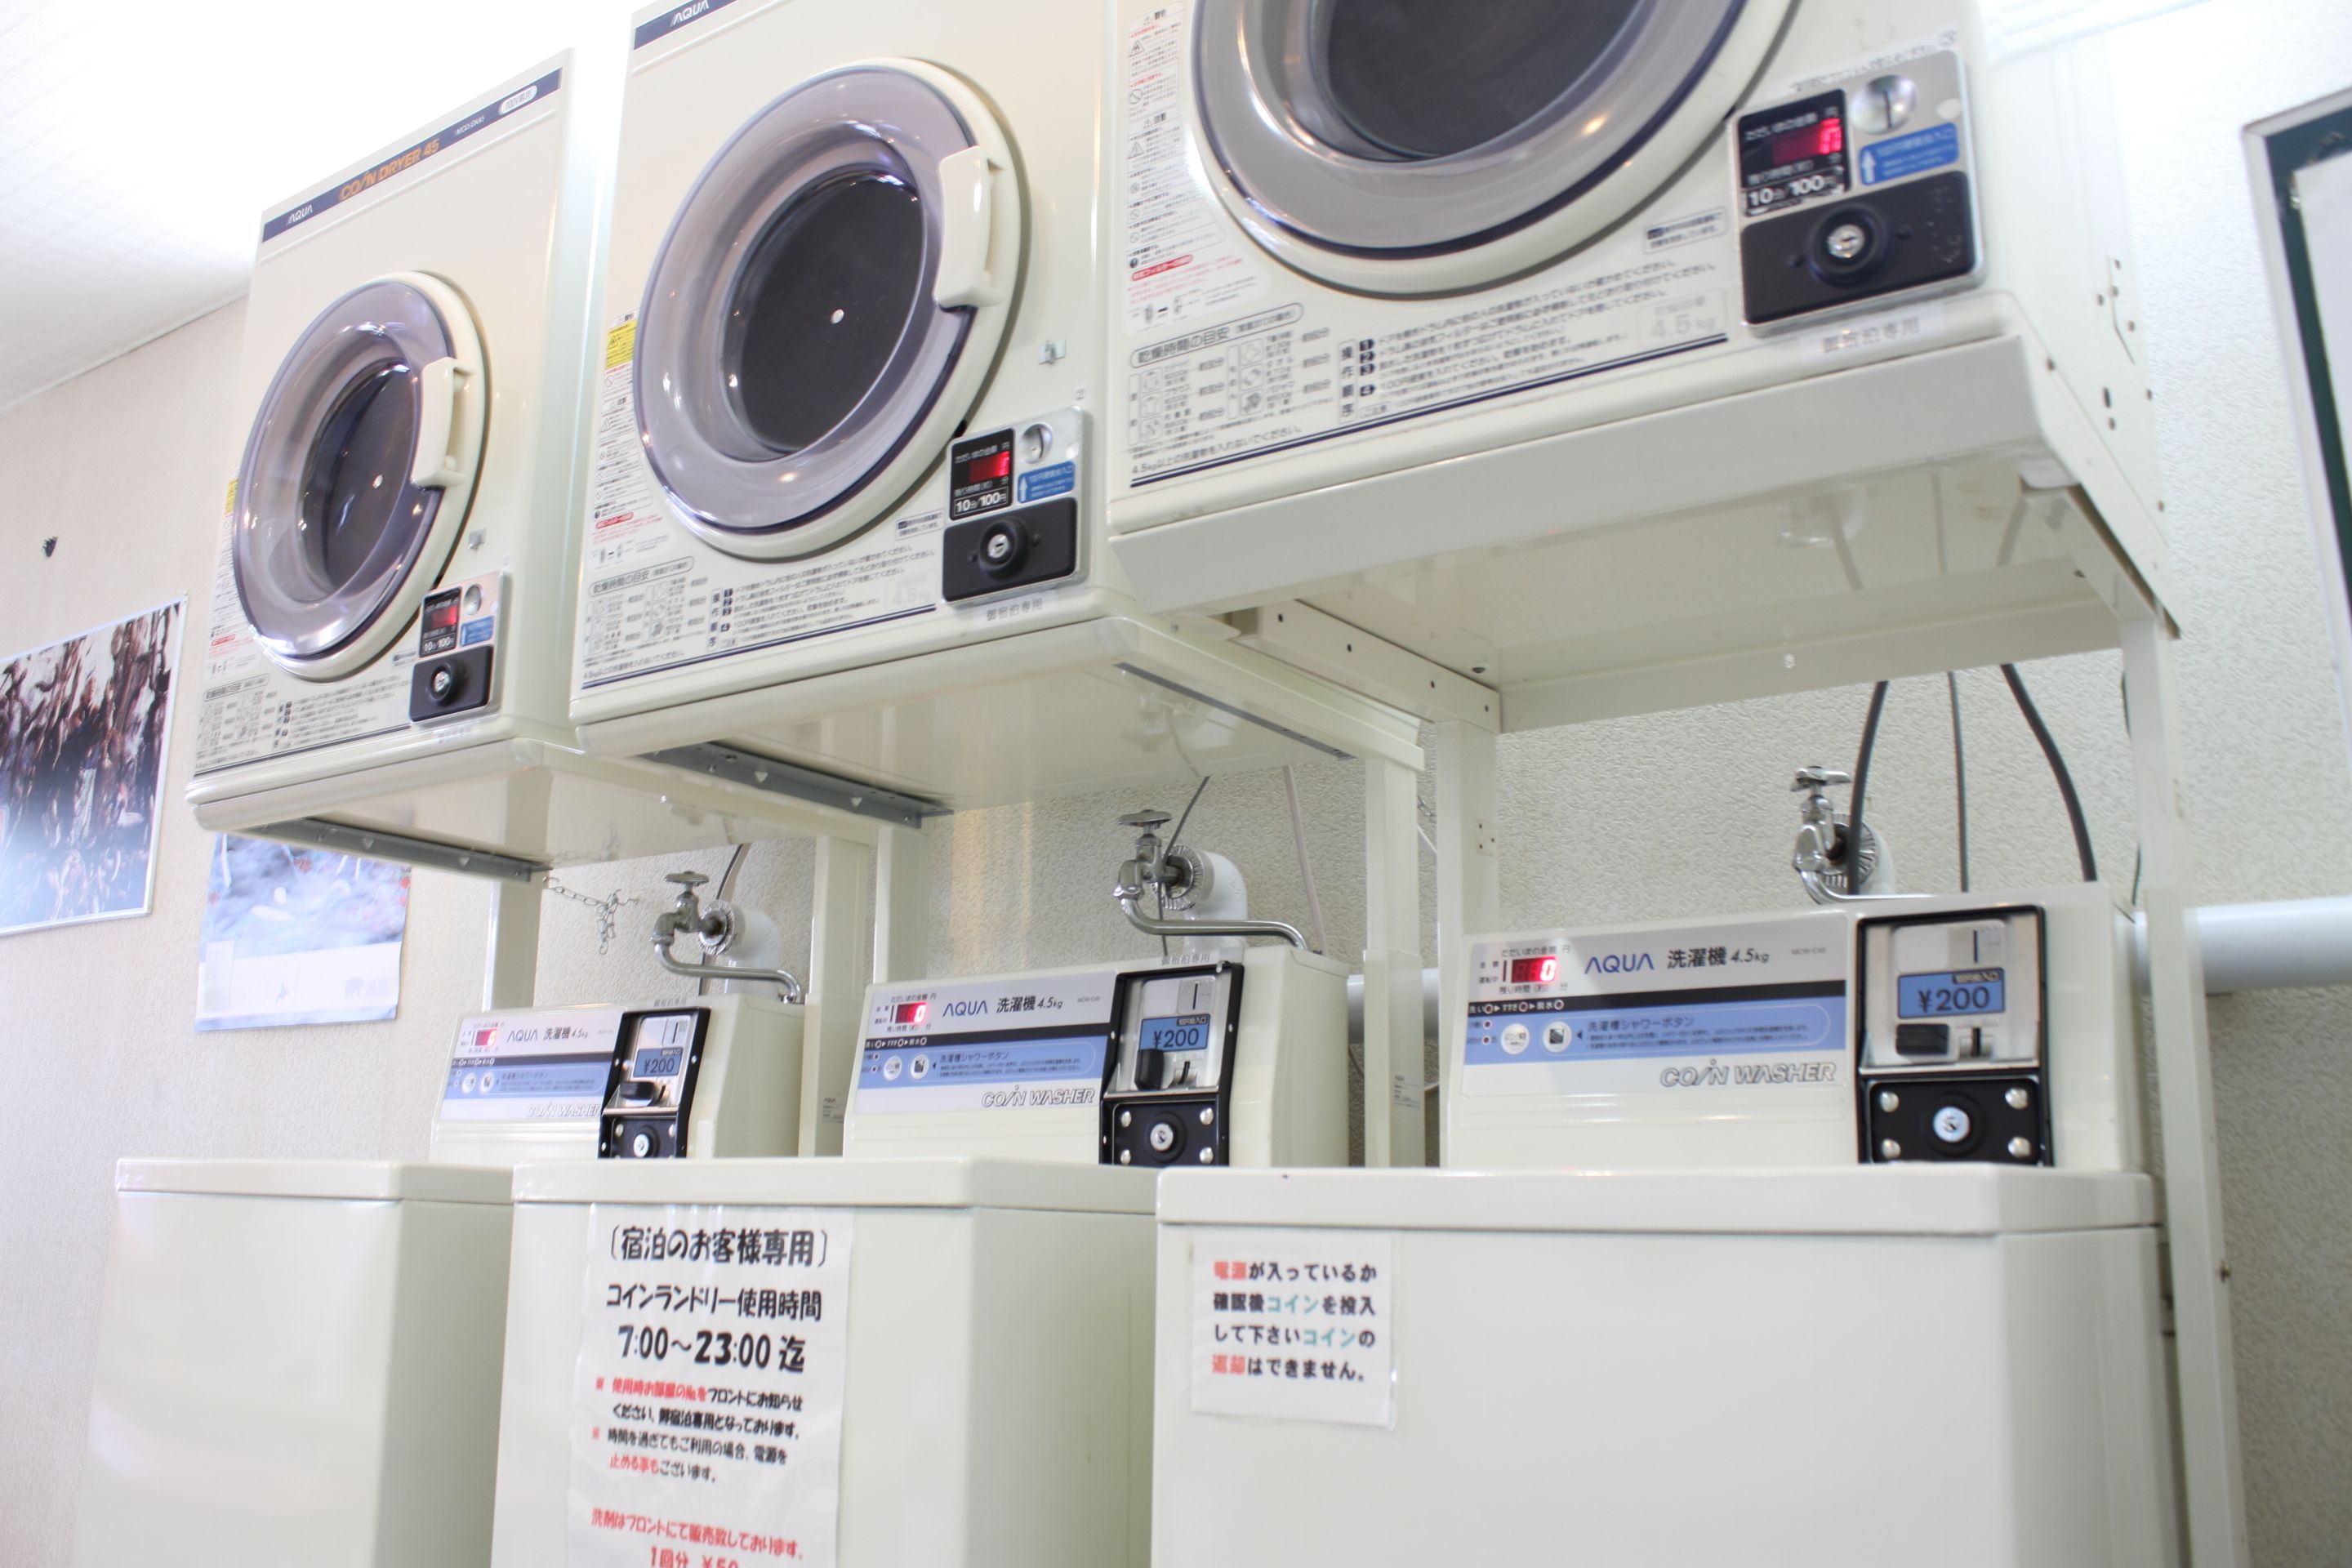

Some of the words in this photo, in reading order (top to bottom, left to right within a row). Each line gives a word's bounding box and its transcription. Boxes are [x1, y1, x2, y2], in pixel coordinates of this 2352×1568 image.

[670, 0, 709, 26] AQUA
[379, 147, 421, 181] DRYER
[422, 138, 440, 157] 45
[287, 204, 314, 225] AQUA
[1585, 953, 1655, 974] AQUA
[1667, 947, 1728, 969] 洗濯機
[1730, 947, 1769, 964] 4.5kg
[1539, 959, 1557, 982] 0
[942, 1000, 988, 1017] AQUA
[996, 996, 1036, 1013] 洗濯機
[1037, 997, 1063, 1009] 4.5kg
[1918, 986, 1990, 1013] ¥200
[915, 1005, 926, 1023] 0
[507, 1028, 537, 1043] AQUA
[543, 1027, 570, 1040] 洗濯機
[1153, 1028, 1200, 1049] ¥200
[644, 1058, 675, 1075] ¥200
[1735, 1062, 1836, 1085] WASHER
[1029, 1088, 1094, 1106] WASHER
[557, 1102, 602, 1117] WASHER
[607, 1284, 822, 1321] コインランドリー使用時間
[1214, 1293, 1376, 1316] 確認後コインを投入
[1214, 1324, 1376, 1348] して下さいコインの
[778, 1335, 805, 1373] 迄
